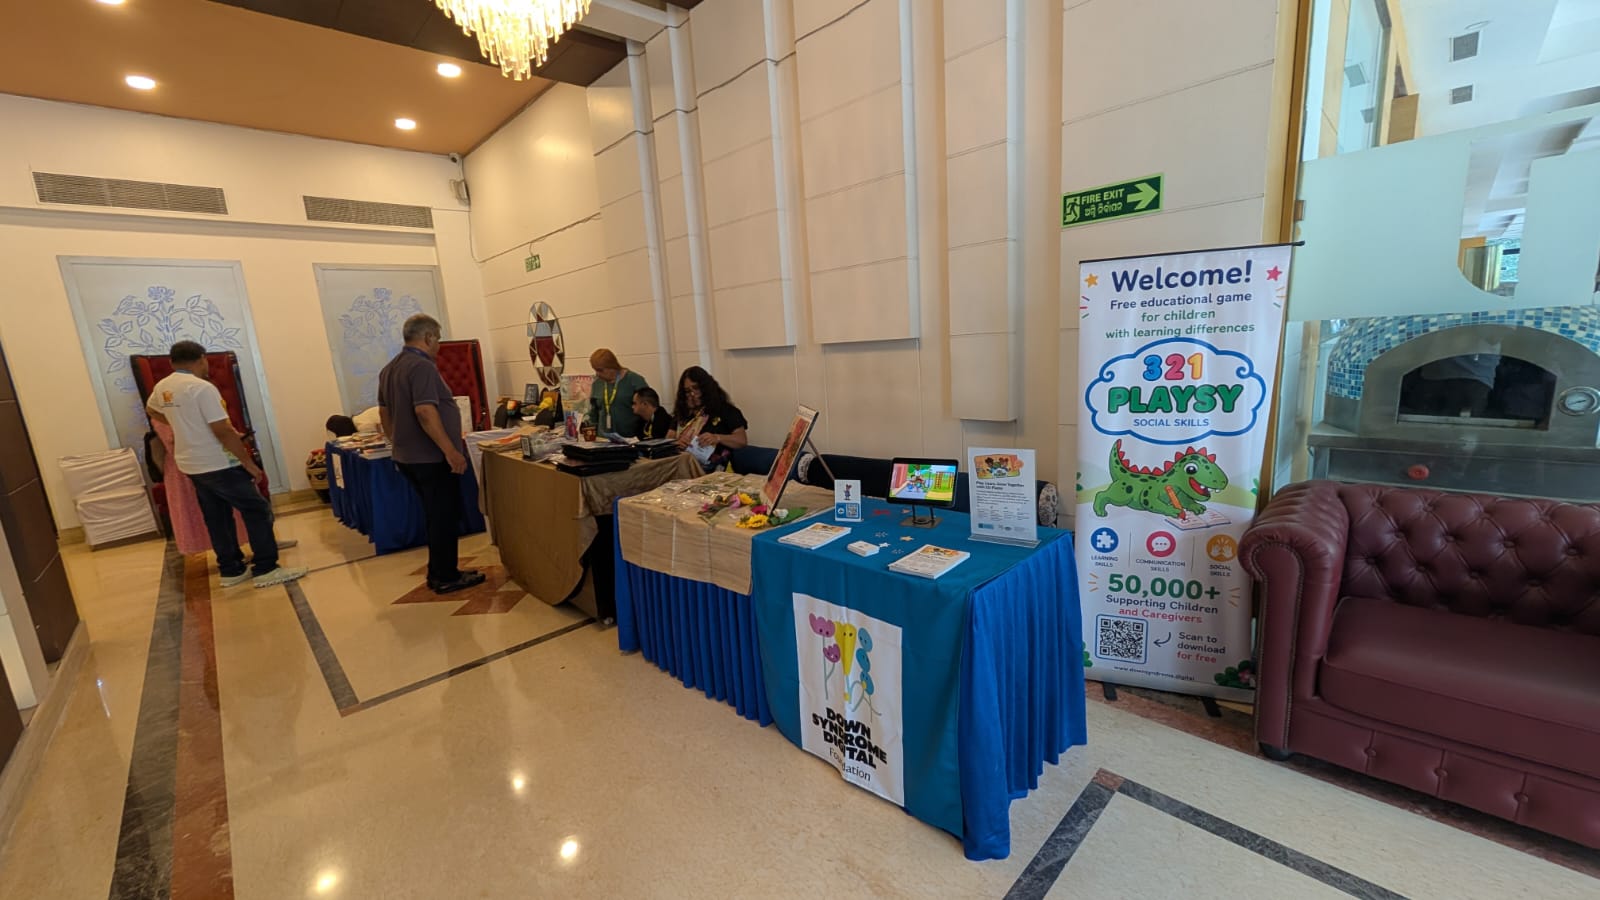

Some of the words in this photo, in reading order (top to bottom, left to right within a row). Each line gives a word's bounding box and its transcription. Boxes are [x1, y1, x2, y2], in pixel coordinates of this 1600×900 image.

[1081, 193, 1102, 205] FIRE
[1103, 188, 1125, 200] EXIT
[1111, 260, 1253, 292] Welcome!
[1110, 299, 1137, 310] Free
[1140, 293, 1212, 308] educational
[1216, 293, 1252, 305] game
[1141, 312, 1160, 322] for
[1164, 310, 1216, 321] children
[1105, 328, 1130, 339] with
[1133, 326, 1181, 338] learning
[1185, 323, 1255, 335] differences
[1142, 352, 1204, 381] 321
[1107, 384, 1244, 414] PLAYSY
[1133, 418, 1171, 427] SOCIAL
[1173, 418, 1210, 427] SKILLS
[1135, 558, 1186, 567] COMMUNICATION
[1108, 573, 1220, 600] 50,000+
[1105, 594, 1166, 611] Supporting
[1169, 600, 1219, 614] Children
[1118, 607, 1138, 617] and
[1141, 609, 1203, 624] Caregivers
[1178, 631, 1204, 642] Scan
[1206, 635, 1218, 644] to
[1177, 641, 1226, 655] download
[1176, 651, 1192, 661] for
[1195, 653, 1217, 664] free
[825, 706, 871, 740] DOWN
[812, 712, 888, 765] SYNDROME
[823, 729, 877, 770] DIGITAL
[829, 746, 871, 782] Foudation
